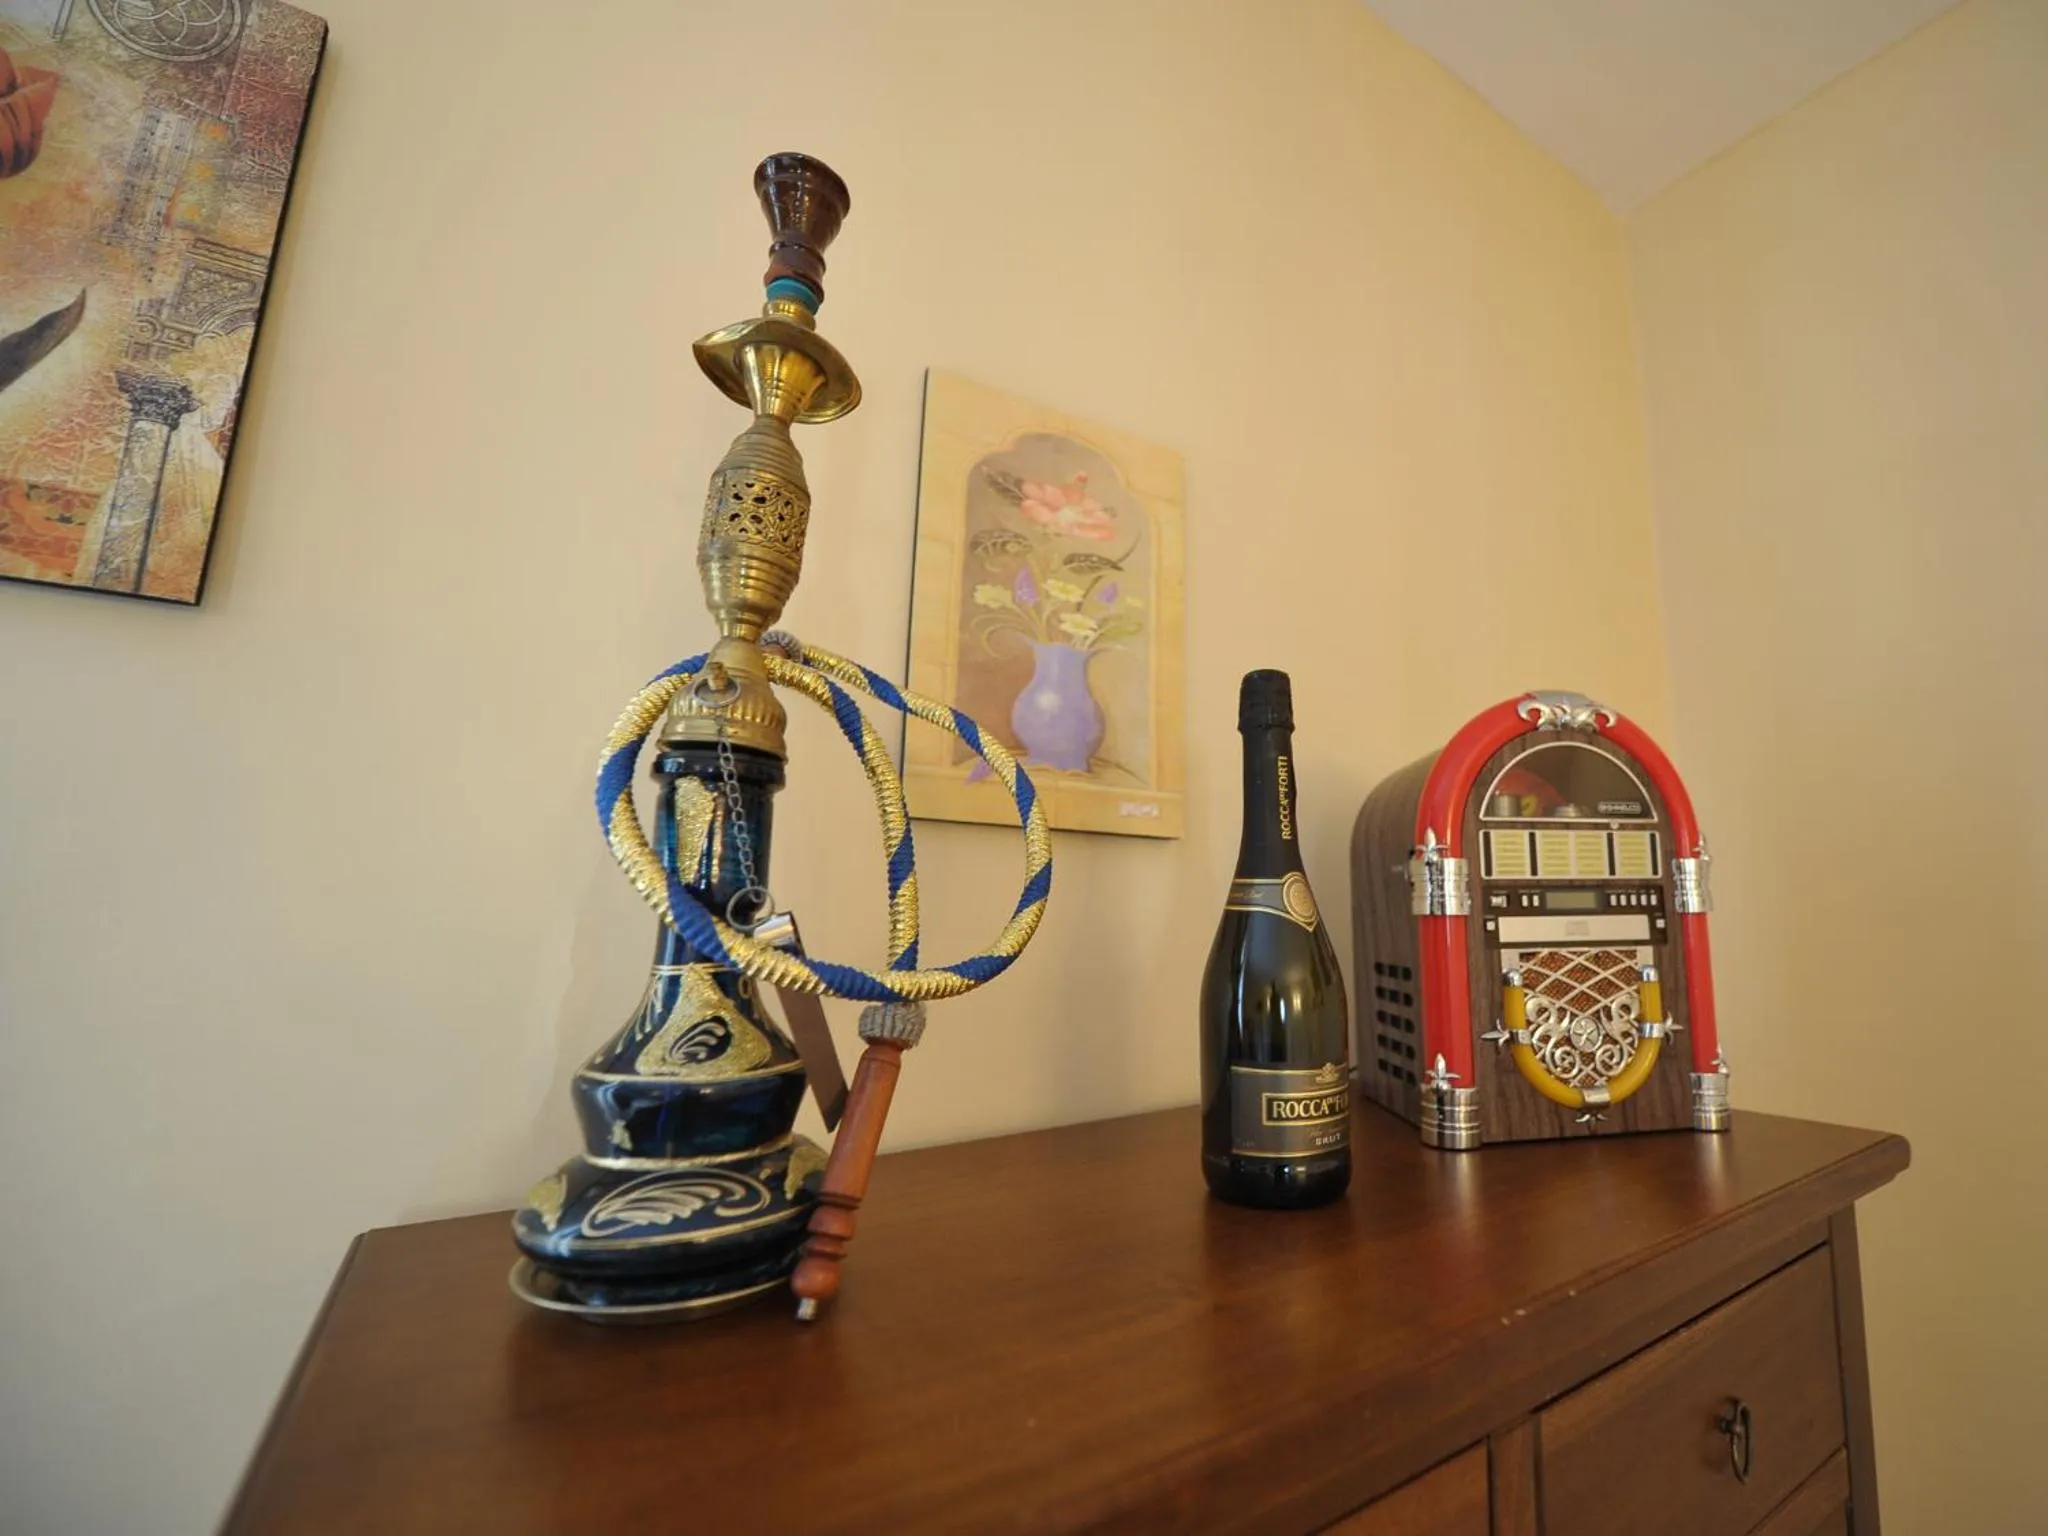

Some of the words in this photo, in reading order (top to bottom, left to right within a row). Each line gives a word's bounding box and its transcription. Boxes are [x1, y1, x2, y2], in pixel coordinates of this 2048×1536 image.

[1278, 755, 1289, 792] FORTI
[1280, 799, 1292, 840] ROCCA
[1272, 1099, 1330, 1118] ROCCA
[1315, 1132, 1341, 1146] BRUT
